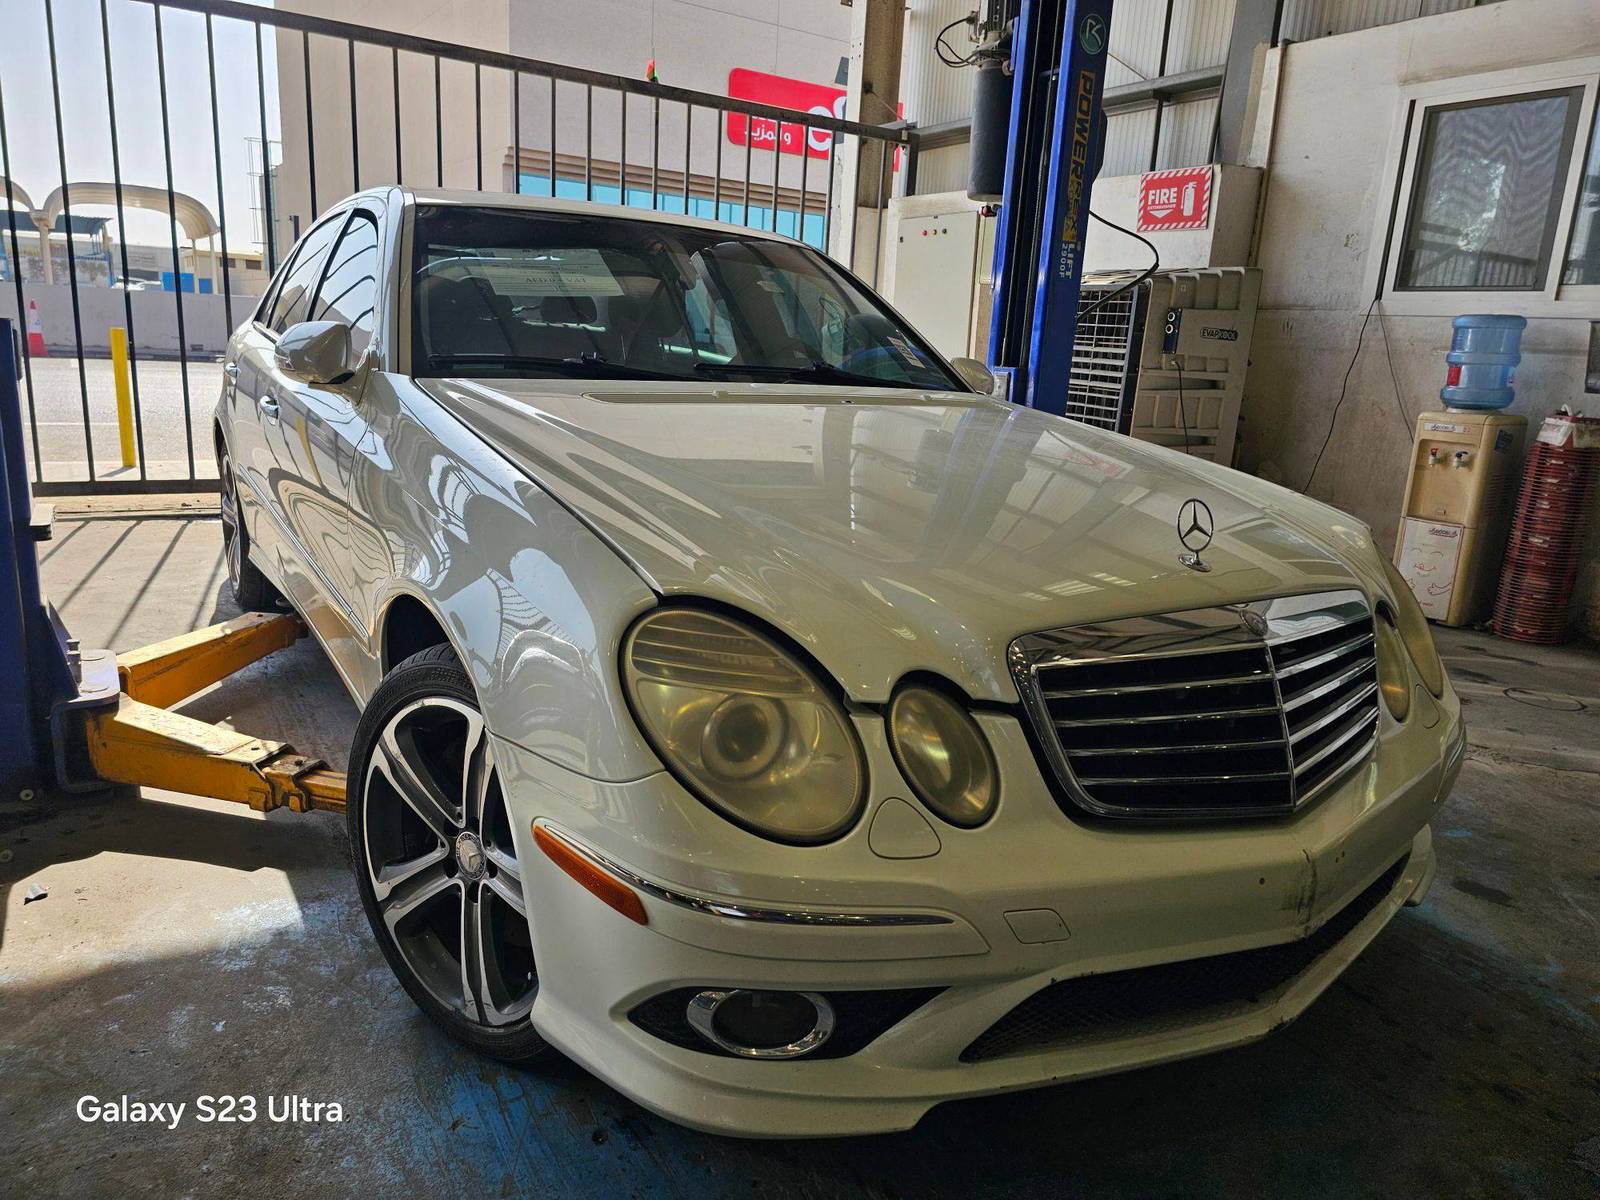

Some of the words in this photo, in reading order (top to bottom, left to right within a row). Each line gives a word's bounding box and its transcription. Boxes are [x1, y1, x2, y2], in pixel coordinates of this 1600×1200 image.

[1148, 187, 1177, 205] FIRE
[1059, 243, 1069, 278] 2900F
[1066, 243, 1076, 279] LIFT
